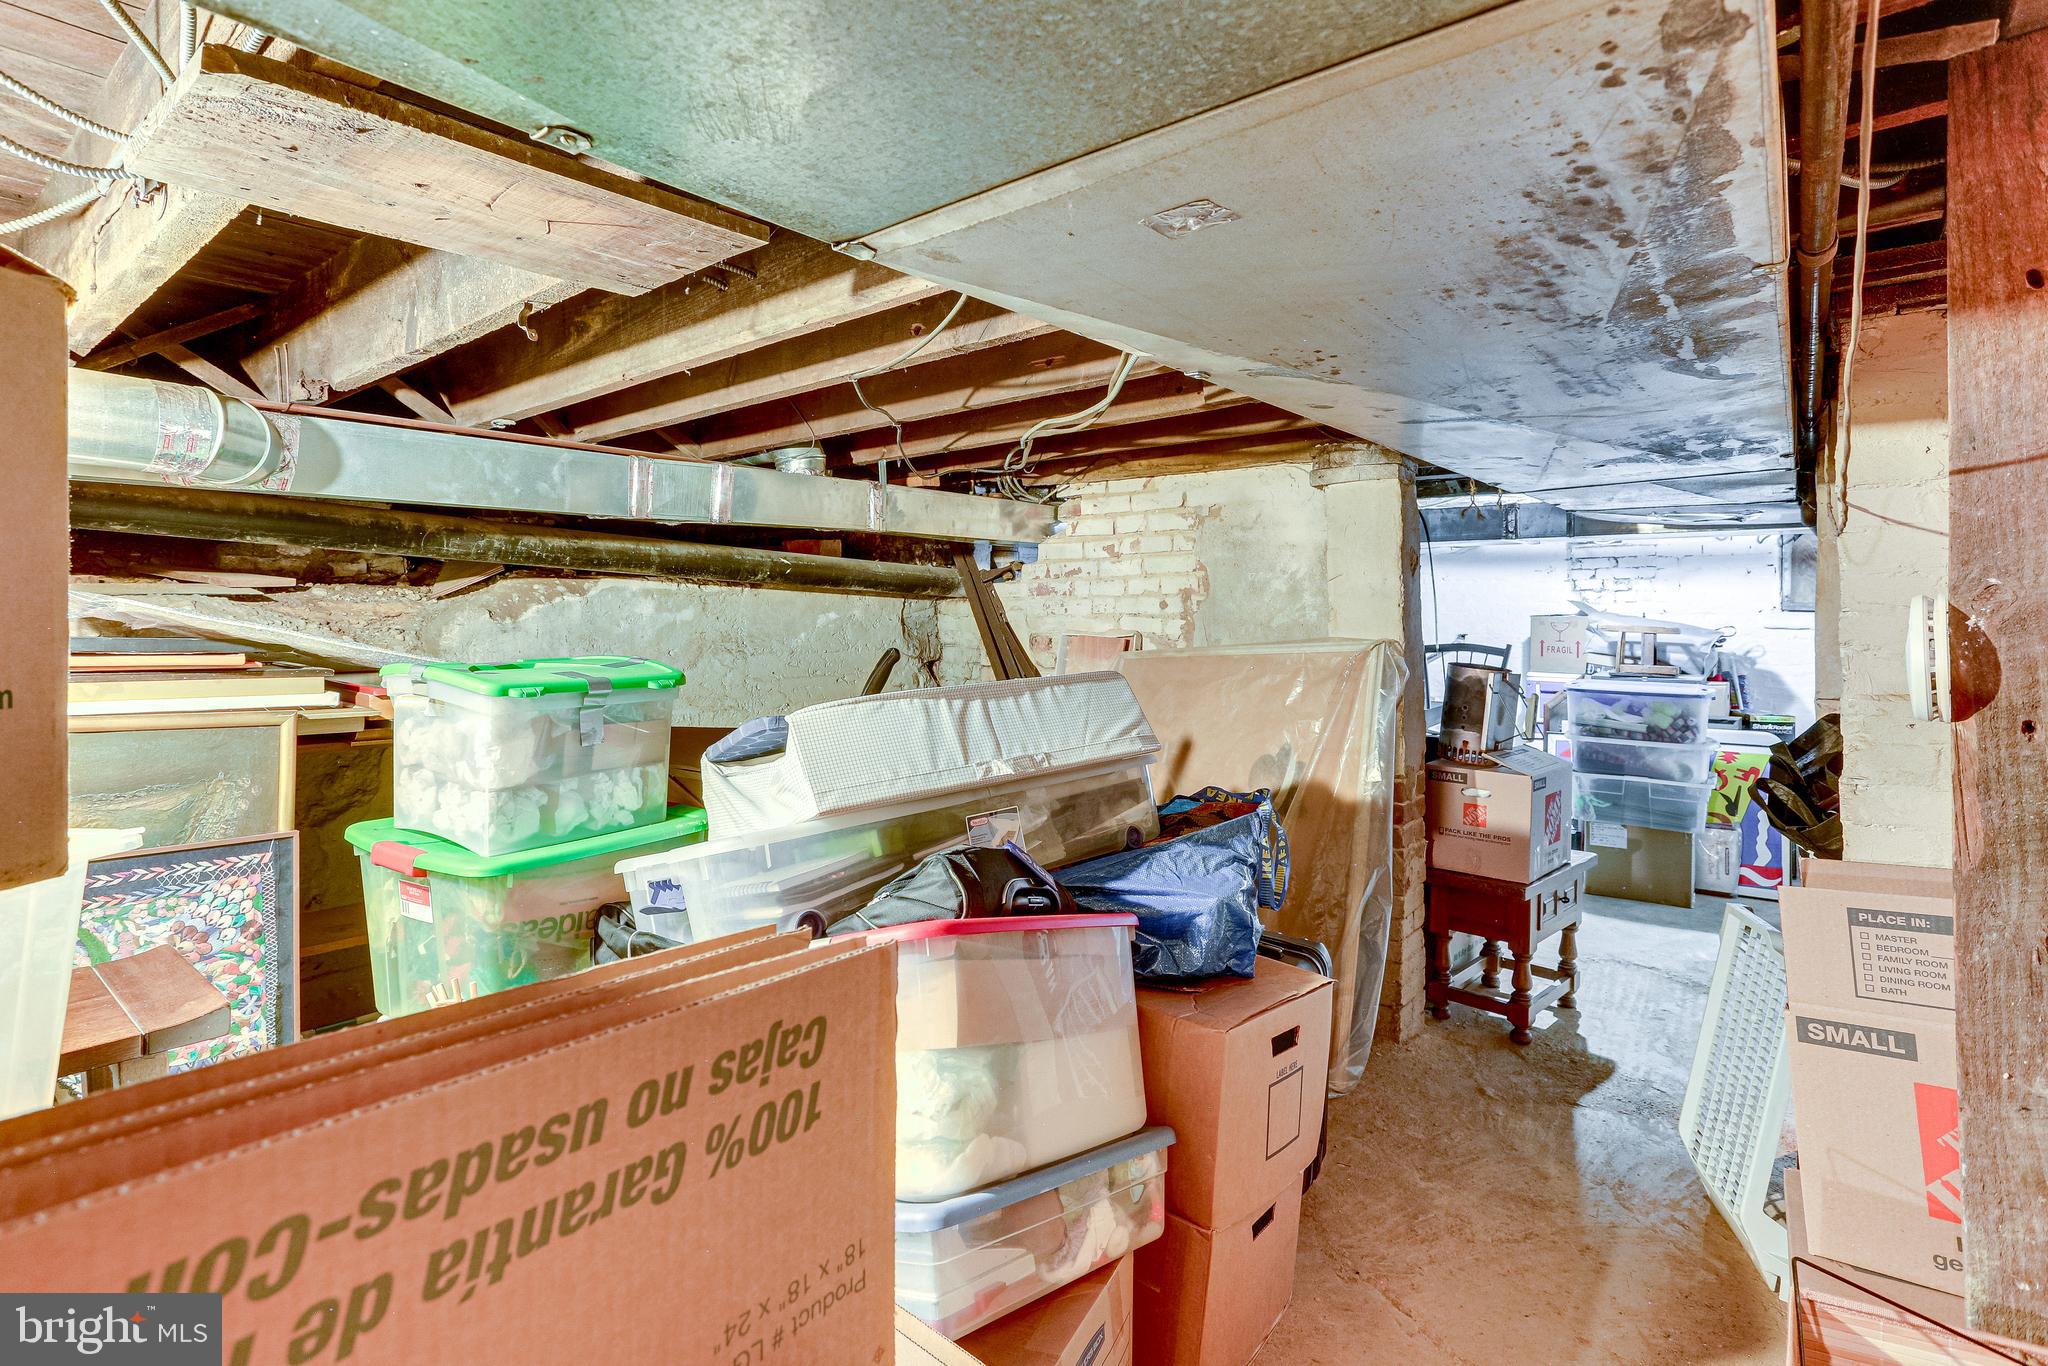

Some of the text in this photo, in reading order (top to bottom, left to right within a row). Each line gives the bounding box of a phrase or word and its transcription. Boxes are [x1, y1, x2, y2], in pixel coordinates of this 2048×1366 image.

[1547, 645, 1572, 654] FRAGIL
[1432, 772, 1464, 783] SMALL
[1445, 827, 1461, 835] PACK
[1463, 830, 1477, 838] LIKE
[1479, 832, 1491, 840] THE
[1493, 834, 1511, 842] PROS
[1858, 912, 1931, 929] PLACE IN:
[1875, 933, 1918, 945] MASTER
[1876, 944, 1930, 957] BEDROOM
[1877, 954, 1949, 970] FAMILY ROOM
[1878, 965, 1947, 980] LIVING ROOM
[1880, 975, 1951, 992] DINING ROOM
[1881, 986, 1907, 996] BATH
[1807, 1022, 1906, 1055] SMALL
[708, 1015, 827, 1096] Cajas
[626, 1064, 695, 1129] no
[288, 1080, 821, 1366] 100% Garantía de
[792, 1268, 866, 1336] Product
